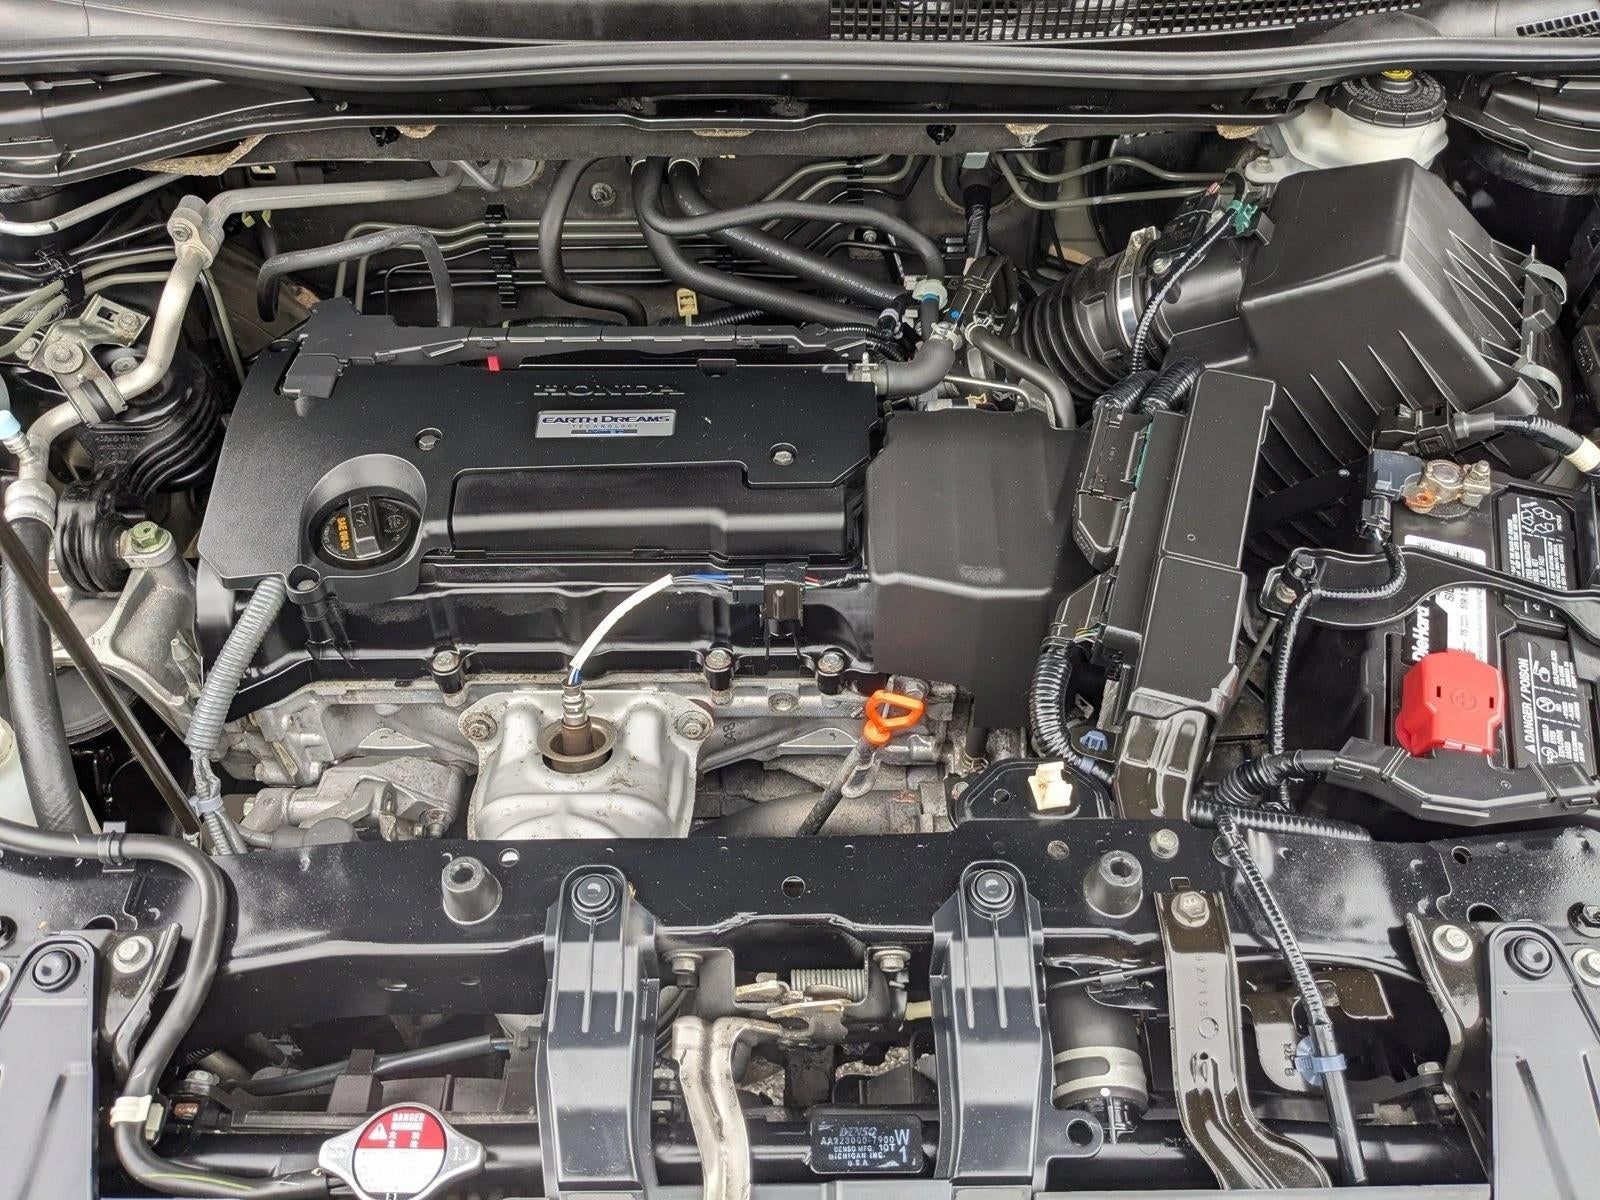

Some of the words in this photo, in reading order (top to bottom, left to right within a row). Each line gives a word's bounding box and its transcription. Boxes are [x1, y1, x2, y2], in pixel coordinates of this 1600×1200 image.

[533, 385, 686, 397] HONDA
[542, 415, 599, 424] EARTH
[600, 415, 671, 424] DREAMS
[336, 516, 348, 532] SAE
[1411, 605, 1430, 662] DieHard
[1517, 657, 1531, 695] POISON
[1521, 701, 1535, 743] DANGER
[1541, 724, 1551, 743] SHIELD
[1555, 729, 1565, 758] EXPLOSIVE
[391, 1112, 426, 1122] DANGER
[839, 1126, 878, 1137] DENSO
[894, 1128, 910, 1146] W
[828, 1152, 866, 1161] MICHIGAN
[833, 1145, 857, 1153] DENSO
